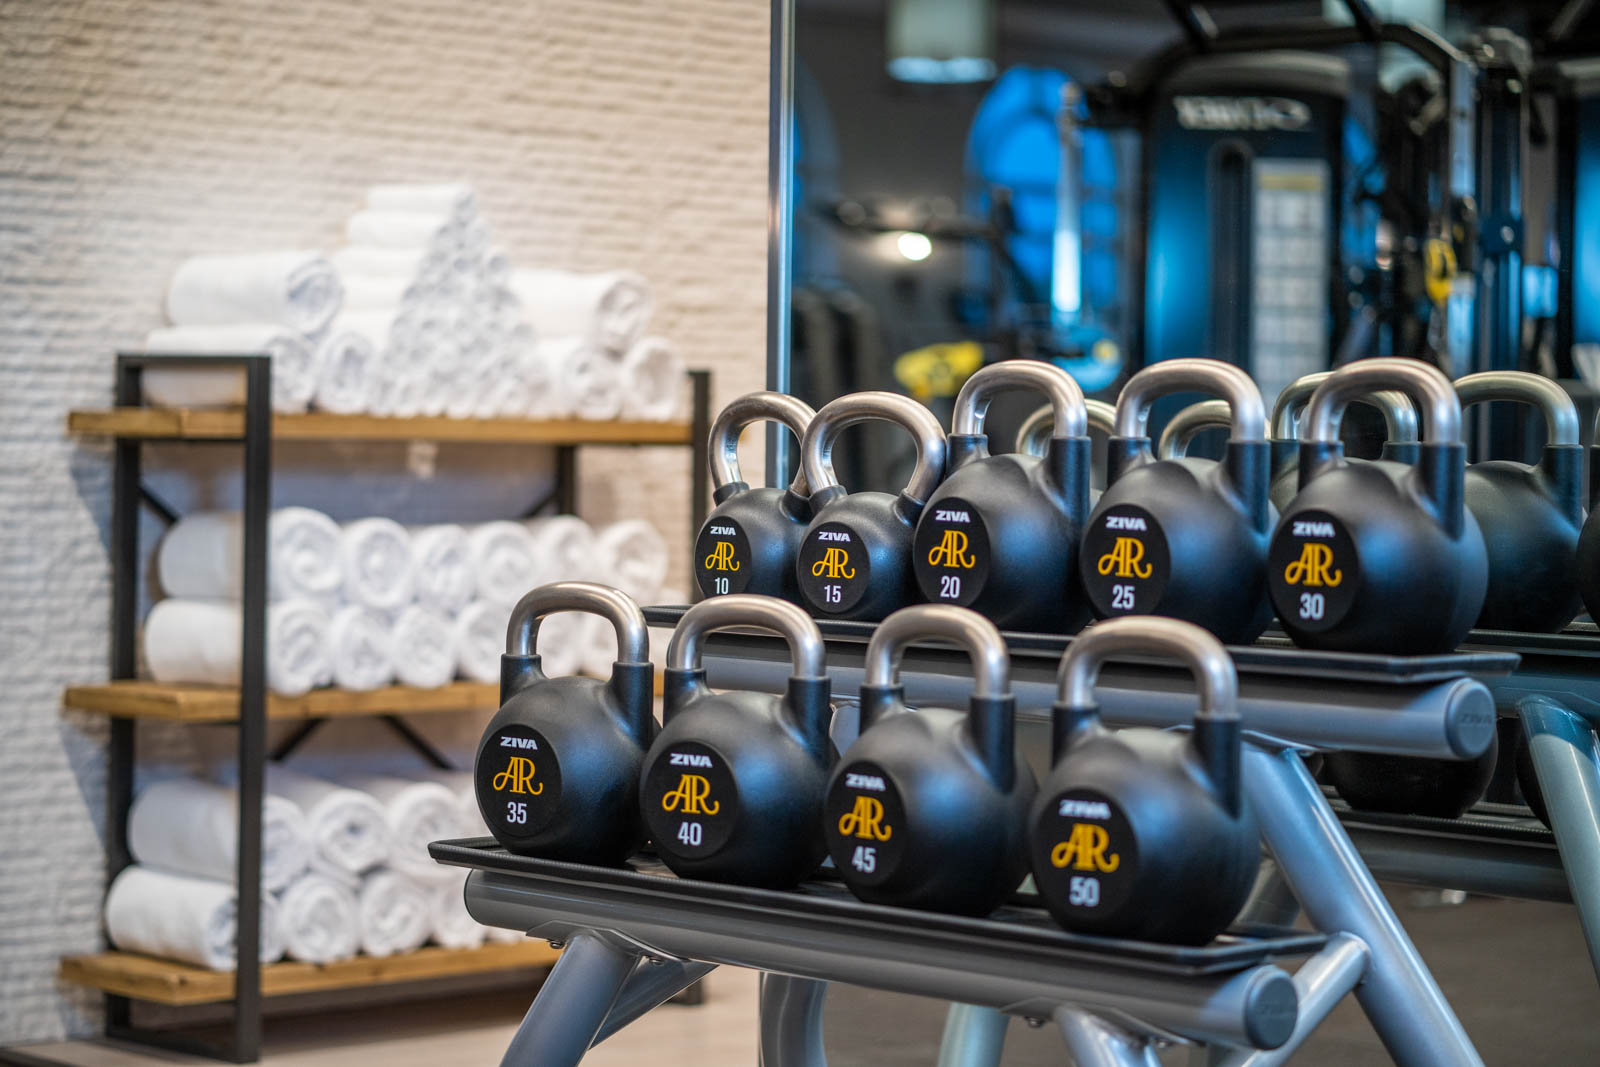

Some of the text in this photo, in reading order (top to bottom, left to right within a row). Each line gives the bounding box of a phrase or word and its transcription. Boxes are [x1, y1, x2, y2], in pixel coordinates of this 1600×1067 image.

[936, 510, 970, 522] ZIVA
[1106, 516, 1146, 530] ZIVA
[711, 526, 736, 535] ZIVA
[819, 532, 850, 542] ZIVA
[1293, 522, 1334, 537] ZIVA
[705, 542, 739, 571] AR
[928, 530, 975, 568] AR
[1098, 538, 1152, 578] AR
[812, 548, 855, 578] AR
[1285, 543, 1342, 586] AR
[713, 577, 728, 594] 10
[824, 585, 841, 603] 15
[941, 576, 960, 598] 20
[1112, 585, 1134, 609] 25
[1300, 593, 1324, 619] 30
[501, 737, 537, 750] ZIVA
[670, 753, 712, 767] ZIVA
[493, 757, 543, 795] AR
[846, 774, 885, 790] ZIVA
[662, 774, 719, 815] AR
[507, 802, 527, 824] 35
[839, 796, 891, 841] AR
[1060, 800, 1110, 819] ZIVA
[678, 822, 702, 845] 40
[852, 846, 875, 872] 45
[1051, 824, 1119, 872] AR
[1070, 877, 1099, 906] 50
